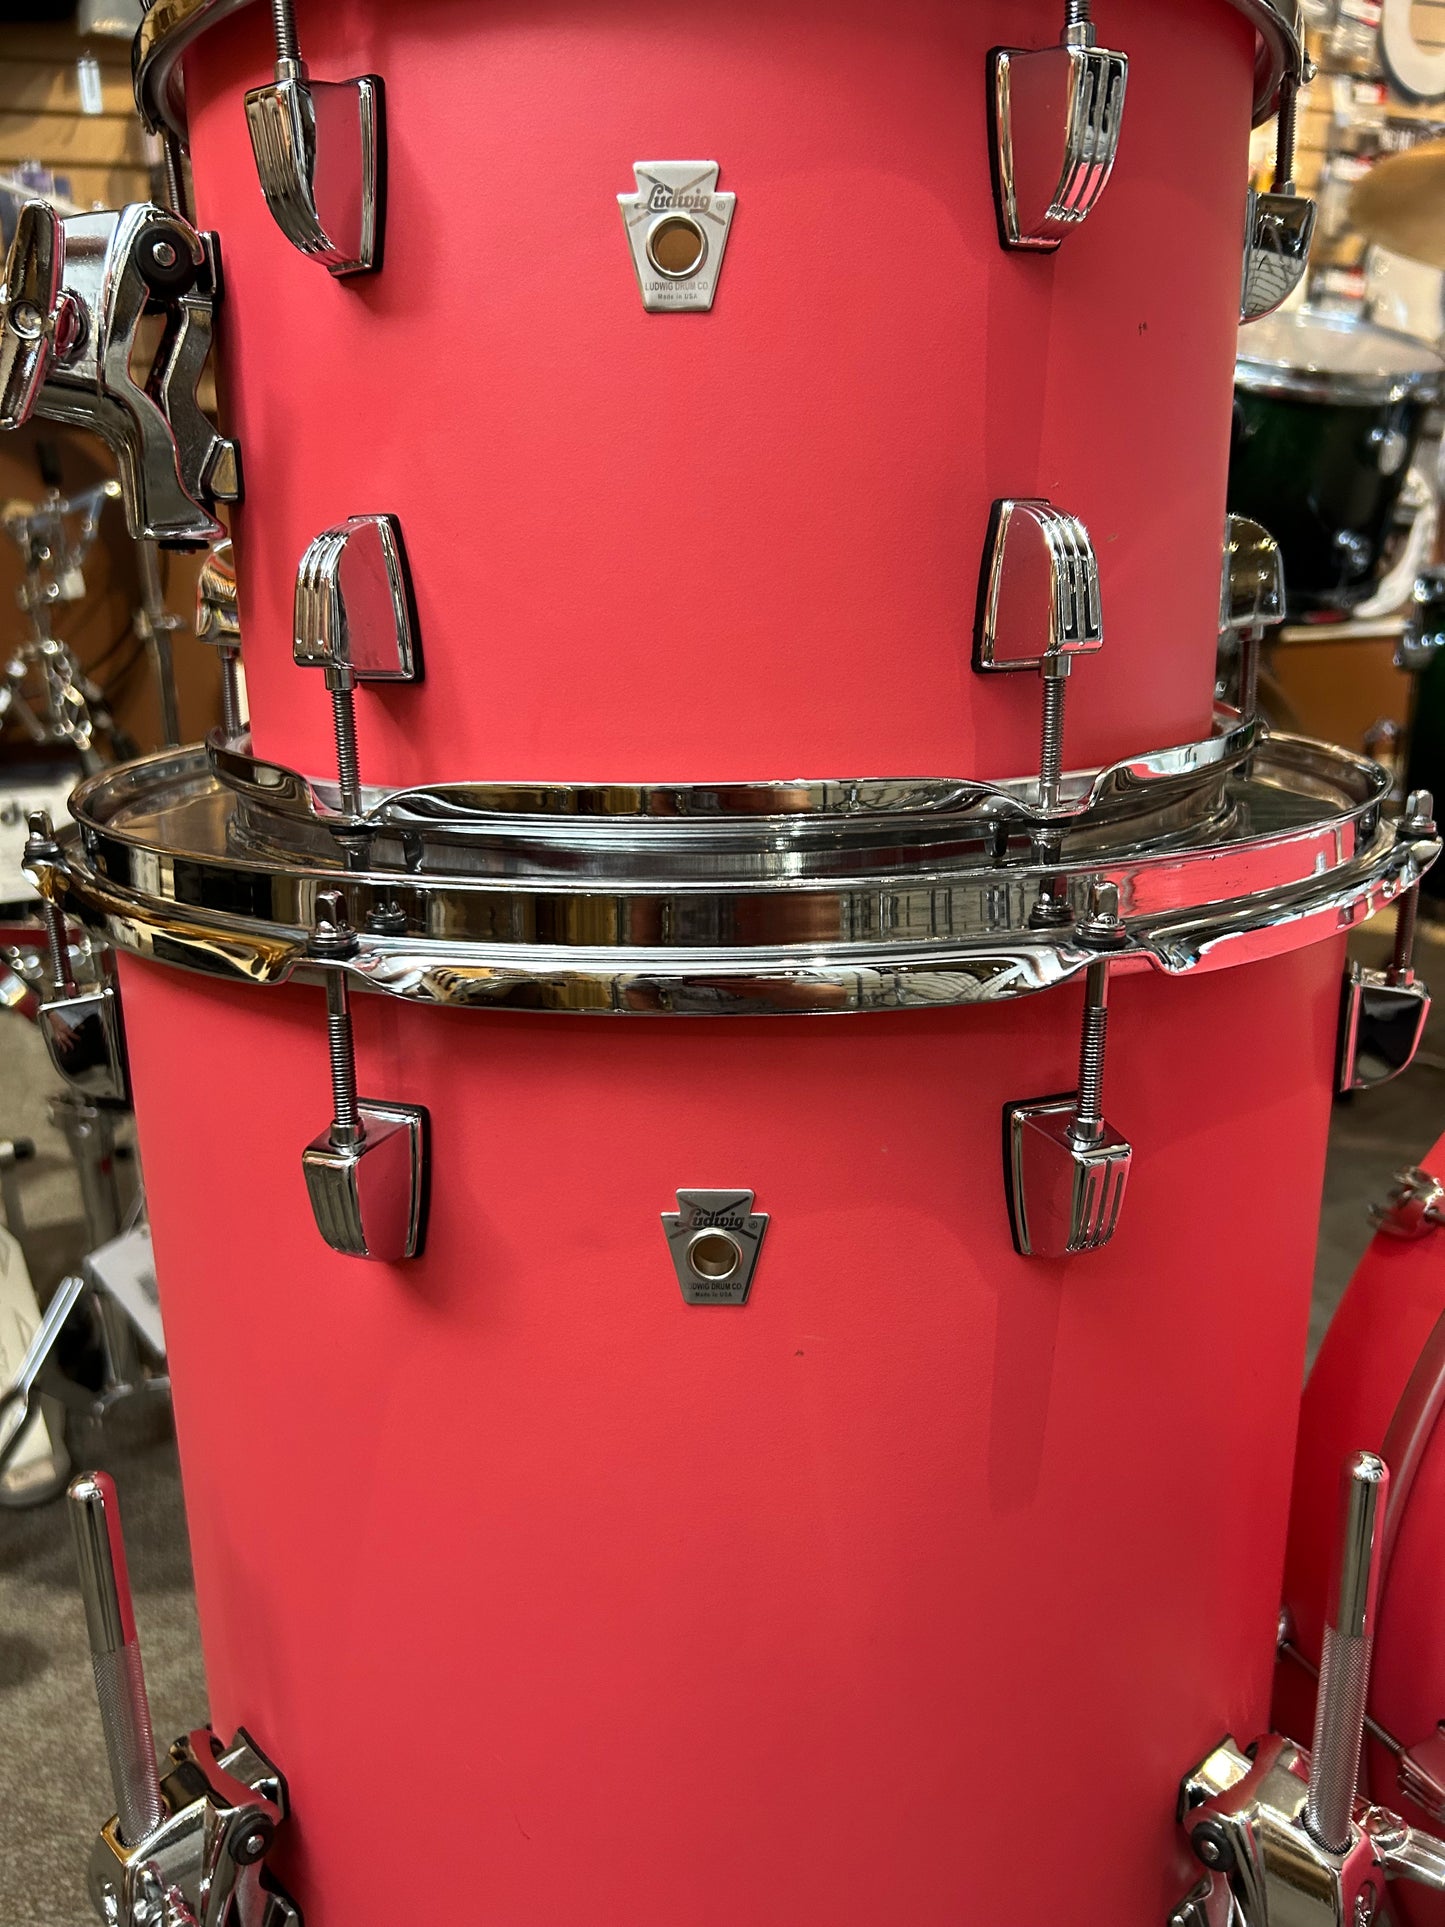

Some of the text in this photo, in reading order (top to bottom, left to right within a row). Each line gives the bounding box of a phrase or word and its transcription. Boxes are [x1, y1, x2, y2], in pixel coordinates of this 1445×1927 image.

[635, 183, 711, 214] Ludwig
[645, 281, 674, 292] LUDWIG
[675, 281, 696, 291] DRUM
[675, 1207, 744, 1231] Ludwig
[711, 1282, 731, 1290] DRUM
